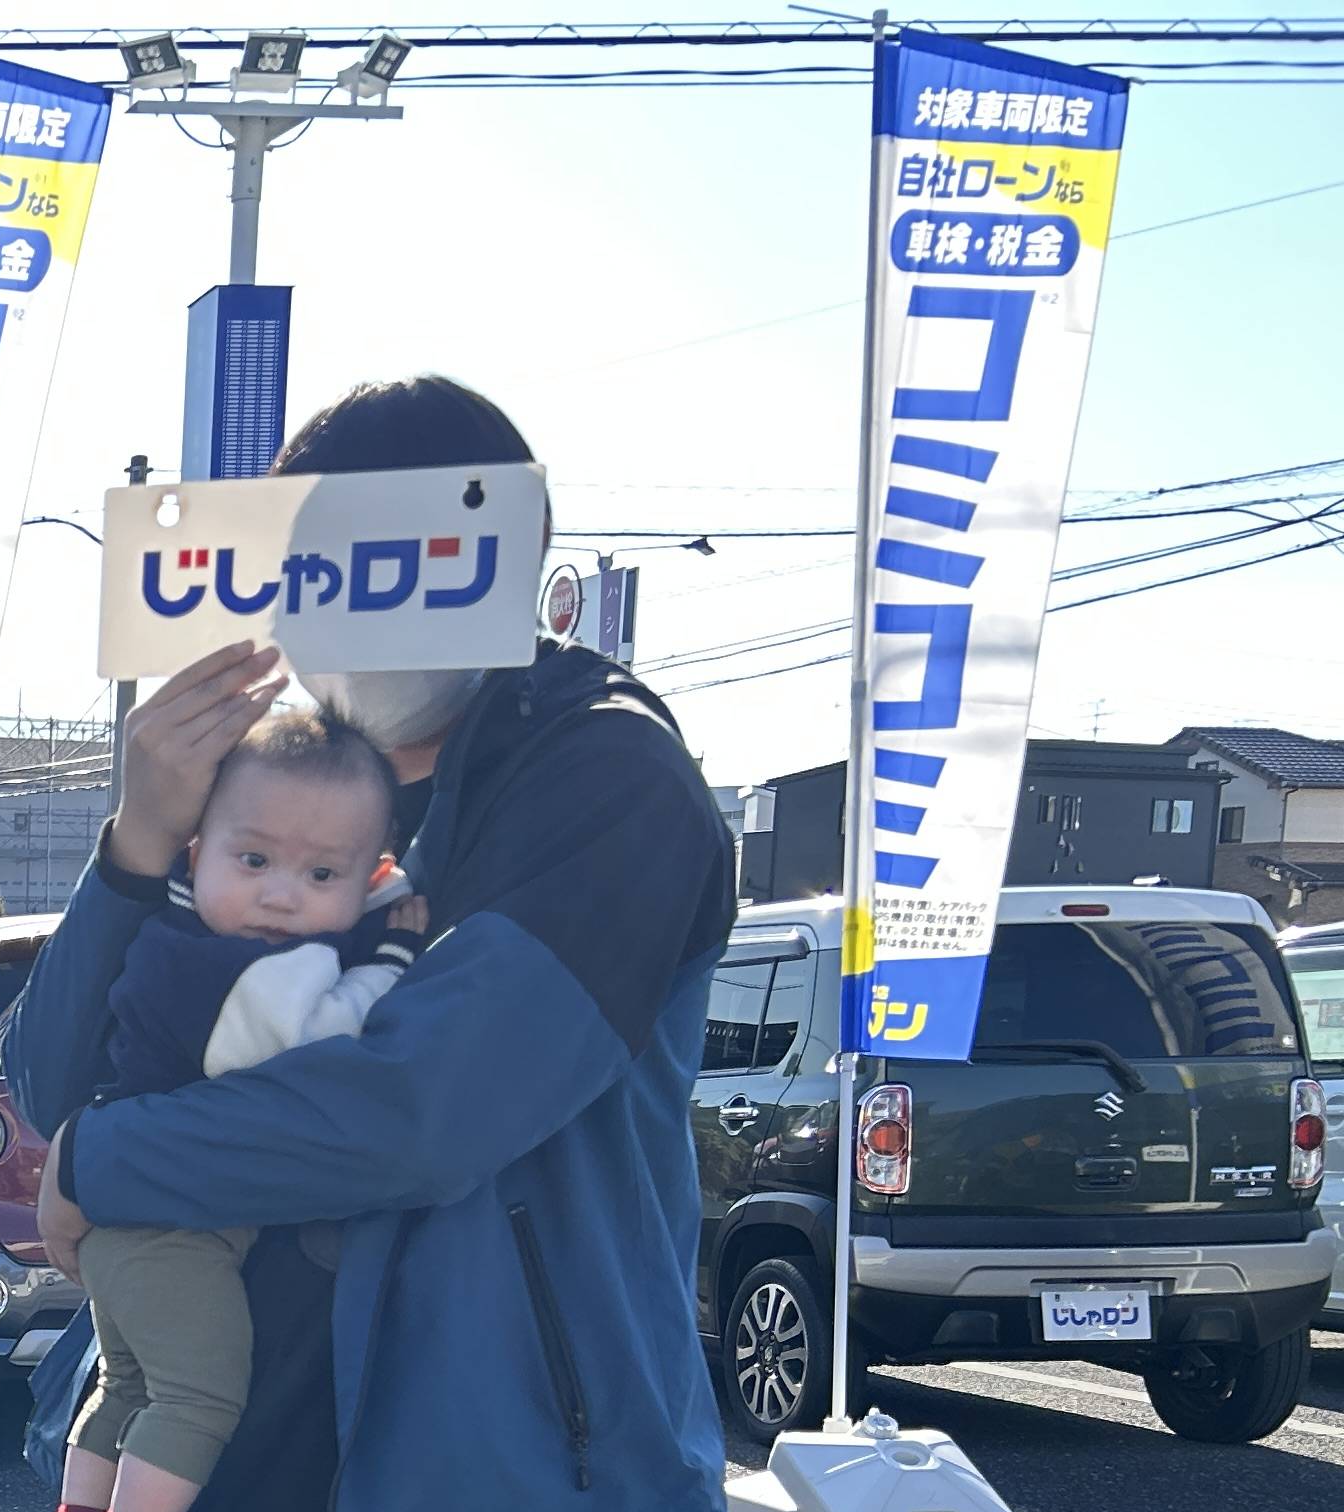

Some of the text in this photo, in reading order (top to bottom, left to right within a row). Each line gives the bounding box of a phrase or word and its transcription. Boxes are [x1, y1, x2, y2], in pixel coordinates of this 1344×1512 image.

[914, 86, 1093, 137] 対象車両限定
[906, 219, 1064, 267] 車検・税金
[141, 535, 499, 618] じしゃロン
[1052, 1306, 1139, 1327] じしゃロン
